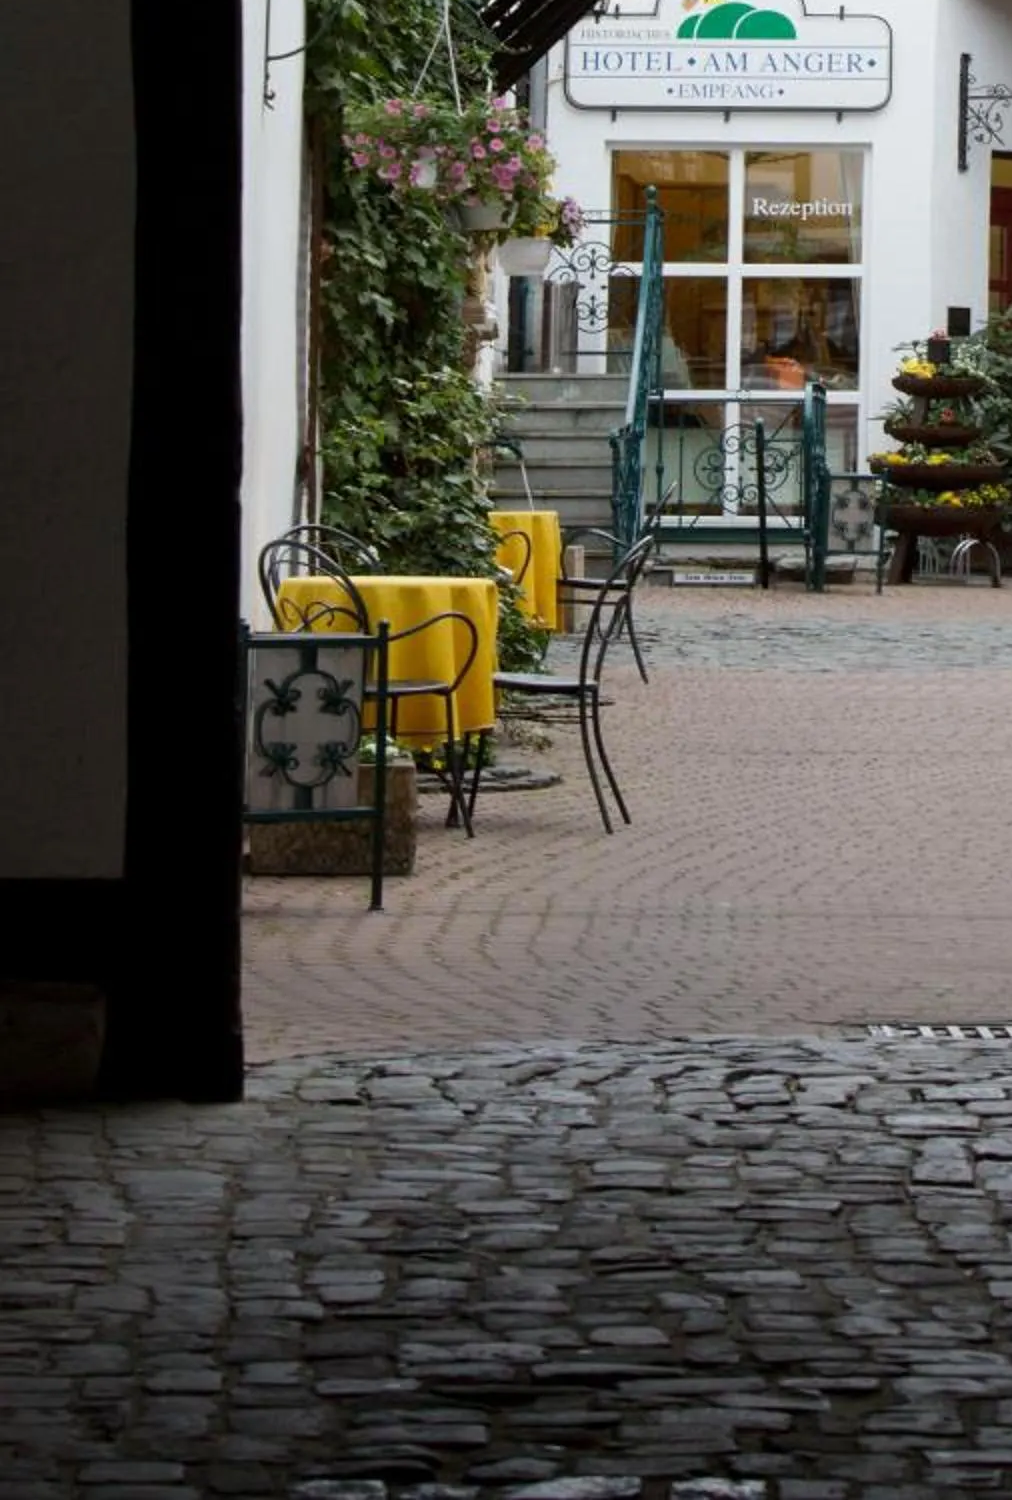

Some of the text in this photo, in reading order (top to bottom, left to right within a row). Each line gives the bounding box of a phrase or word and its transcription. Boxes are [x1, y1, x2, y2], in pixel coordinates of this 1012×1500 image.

[581, 51, 865, 74] HOTEL AM ANGER
[678, 83, 775, 99] EMPFANG
[752, 198, 853, 221] Rezeption
